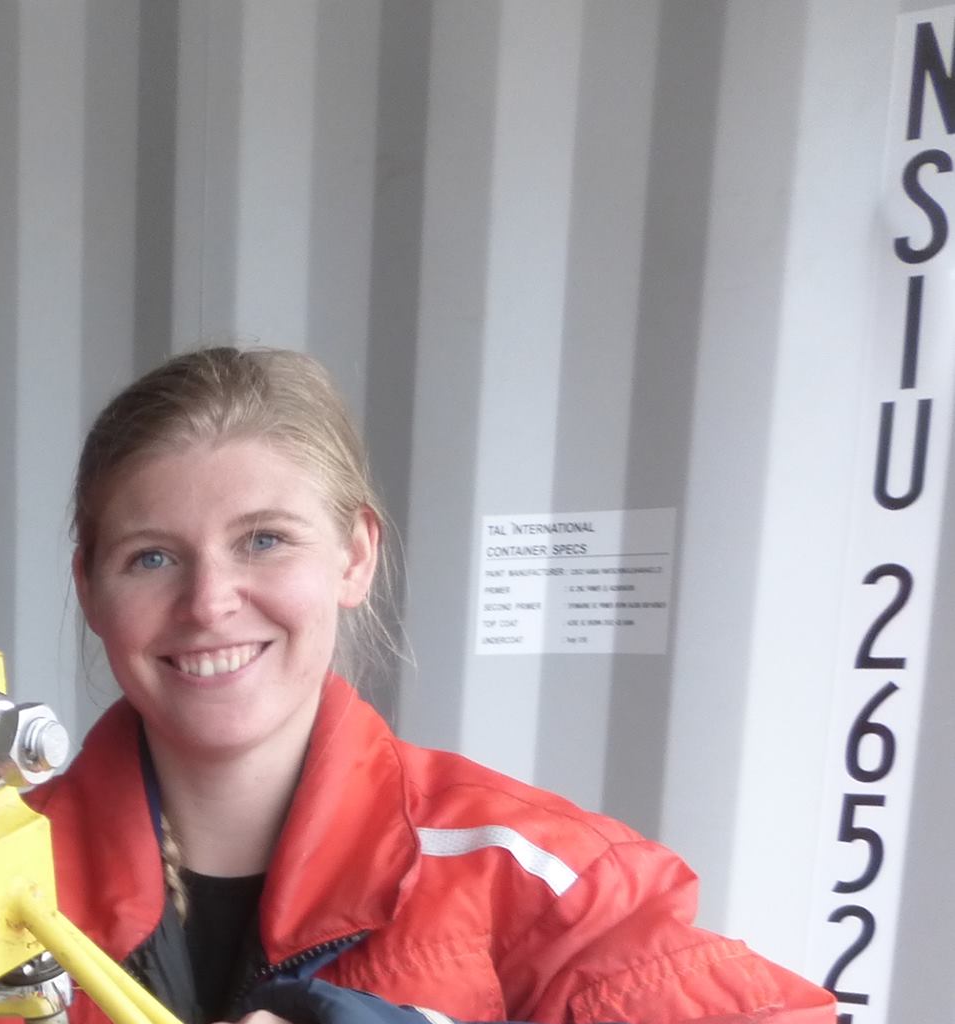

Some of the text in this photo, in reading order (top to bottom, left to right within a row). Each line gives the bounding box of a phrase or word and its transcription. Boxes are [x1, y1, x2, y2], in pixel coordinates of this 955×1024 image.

[488, 521, 595, 536] TAL INTERNATIONAL
[486, 543, 588, 557] CONTAINER SPECS
